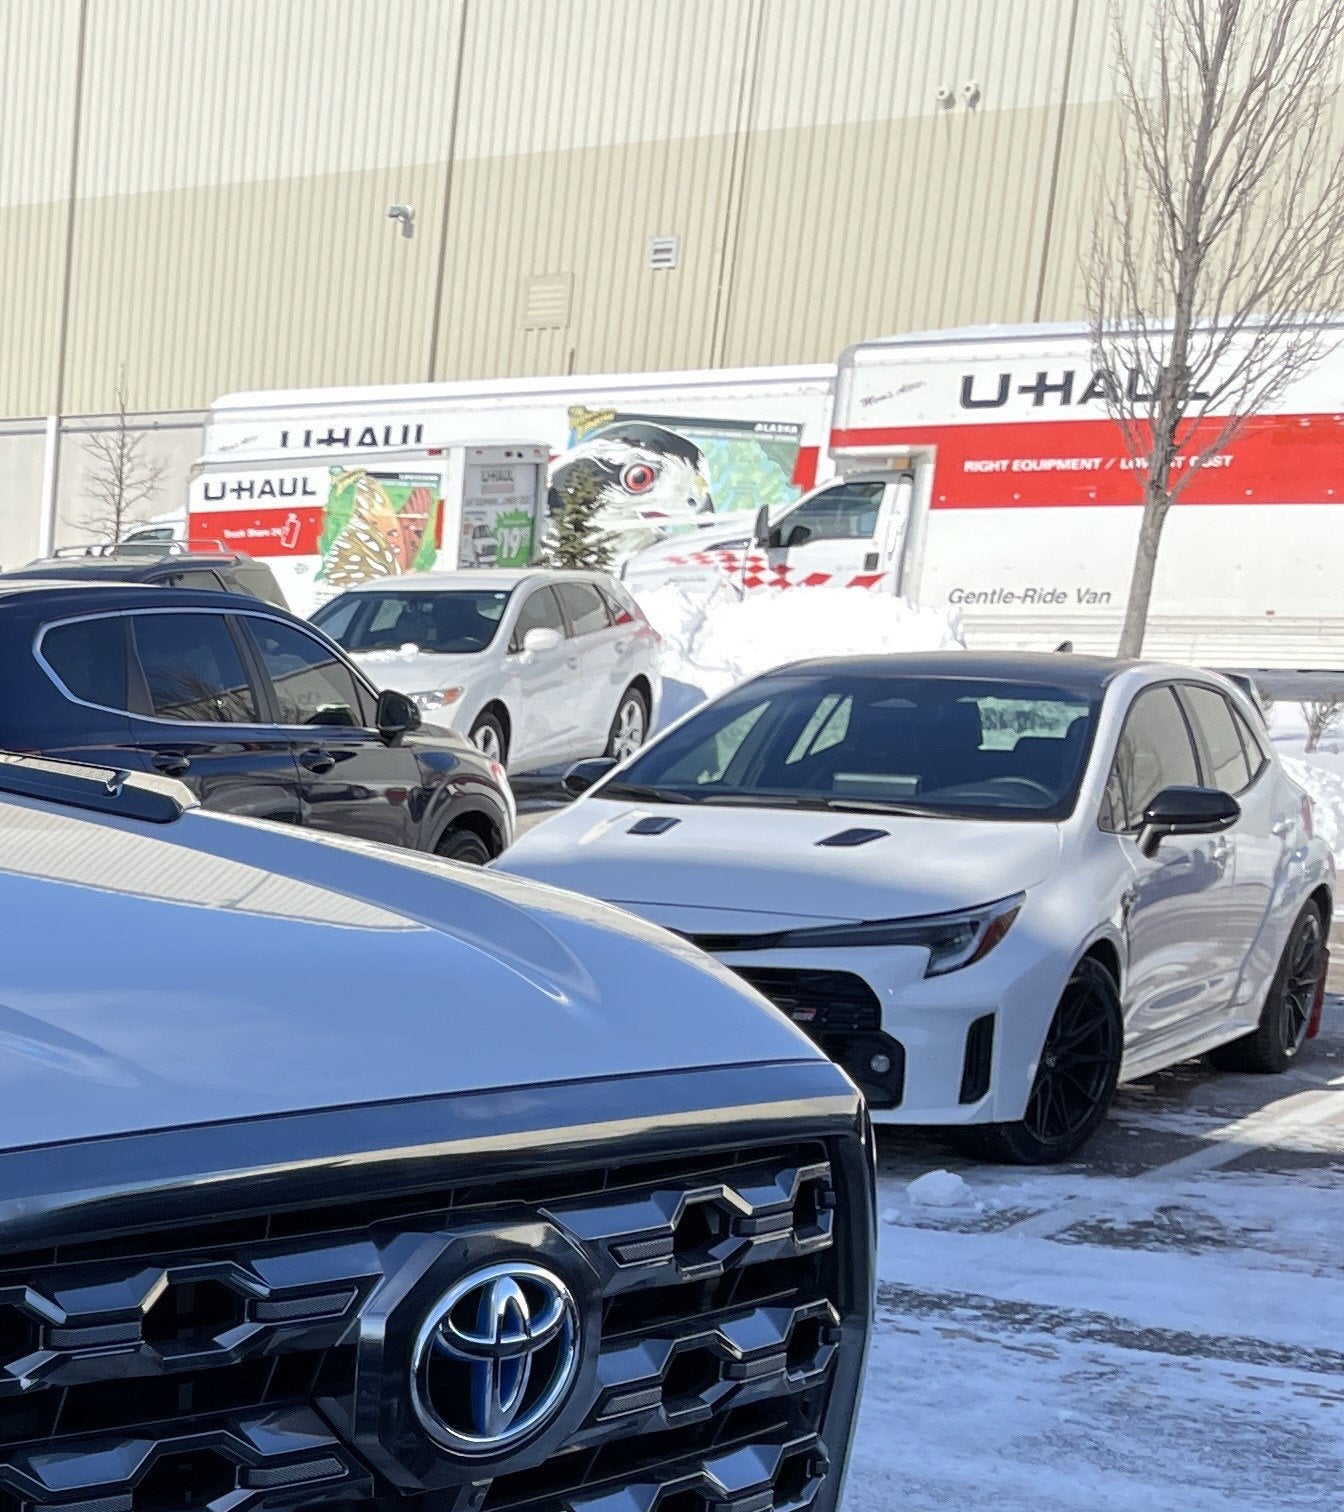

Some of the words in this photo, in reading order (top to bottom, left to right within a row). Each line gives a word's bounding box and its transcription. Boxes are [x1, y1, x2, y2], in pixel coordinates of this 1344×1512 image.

[963, 459, 1011, 473] RIGHT
[1012, 457, 1102, 473] EQUIPMENT
[1119, 456, 1186, 471] LOWT
[203, 477, 317, 501] U-HAUL
[948, 587, 1068, 605] Gentle-Ride
[1076, 587, 1112, 605] Van
